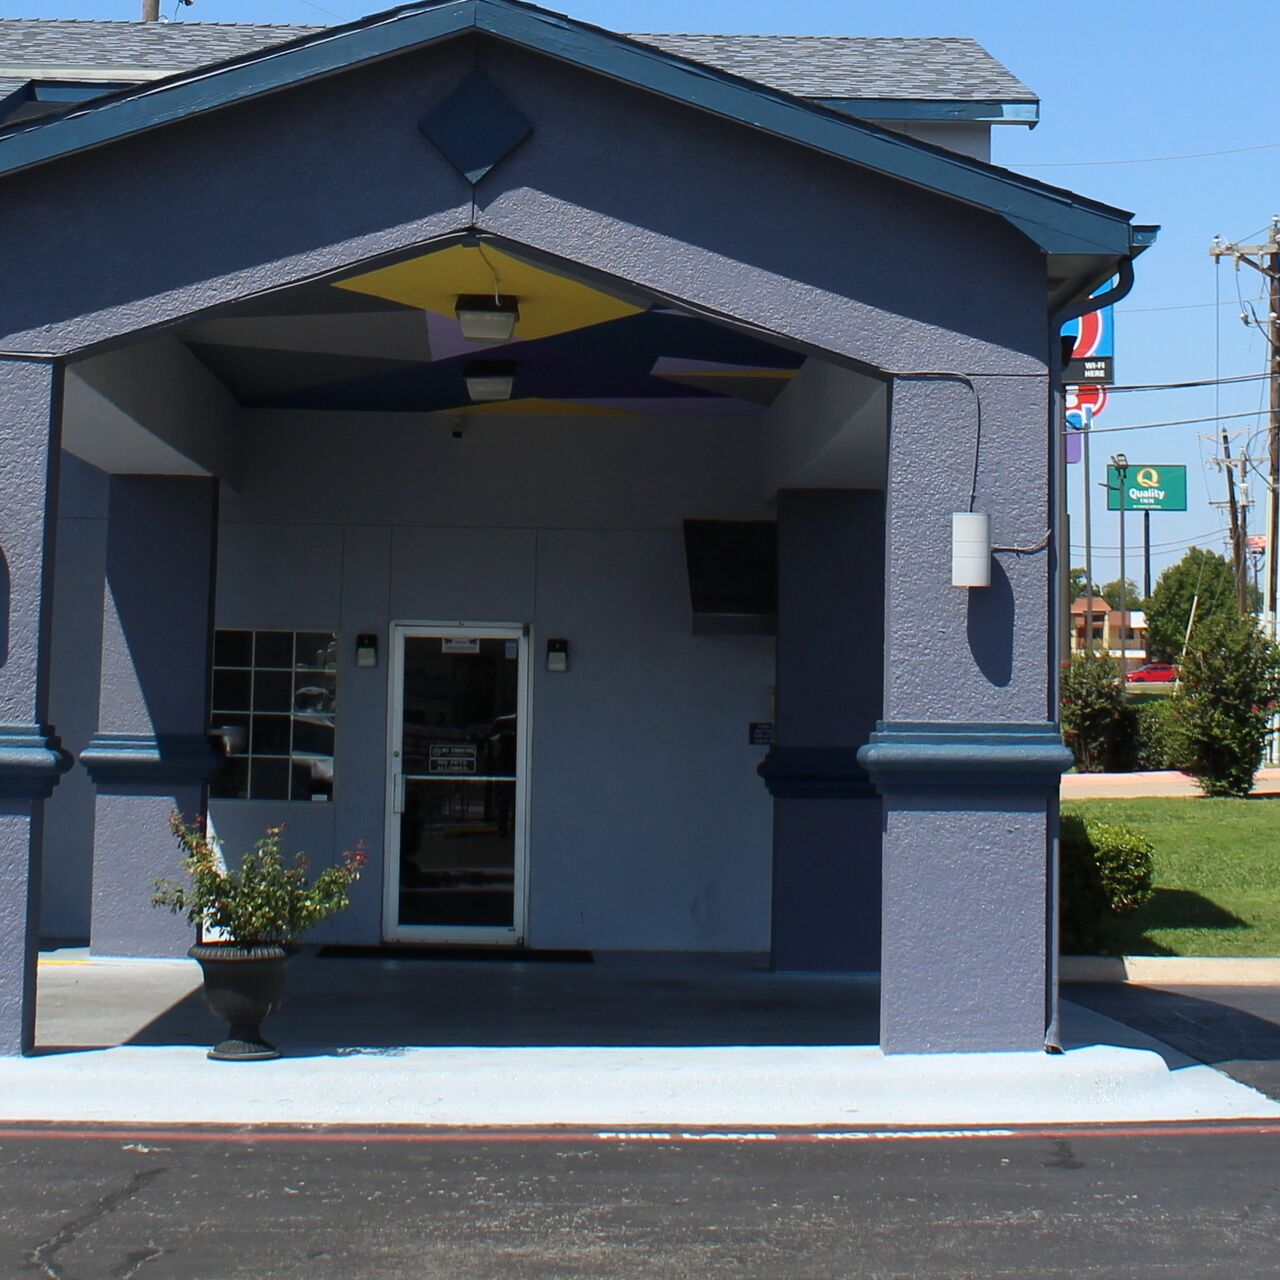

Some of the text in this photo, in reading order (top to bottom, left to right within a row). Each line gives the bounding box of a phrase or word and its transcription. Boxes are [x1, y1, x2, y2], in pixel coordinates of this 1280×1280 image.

[1084, 370, 1105, 378] HERE
[1136, 467, 1160, 488] Q
[1128, 488, 1165, 500] Quality
